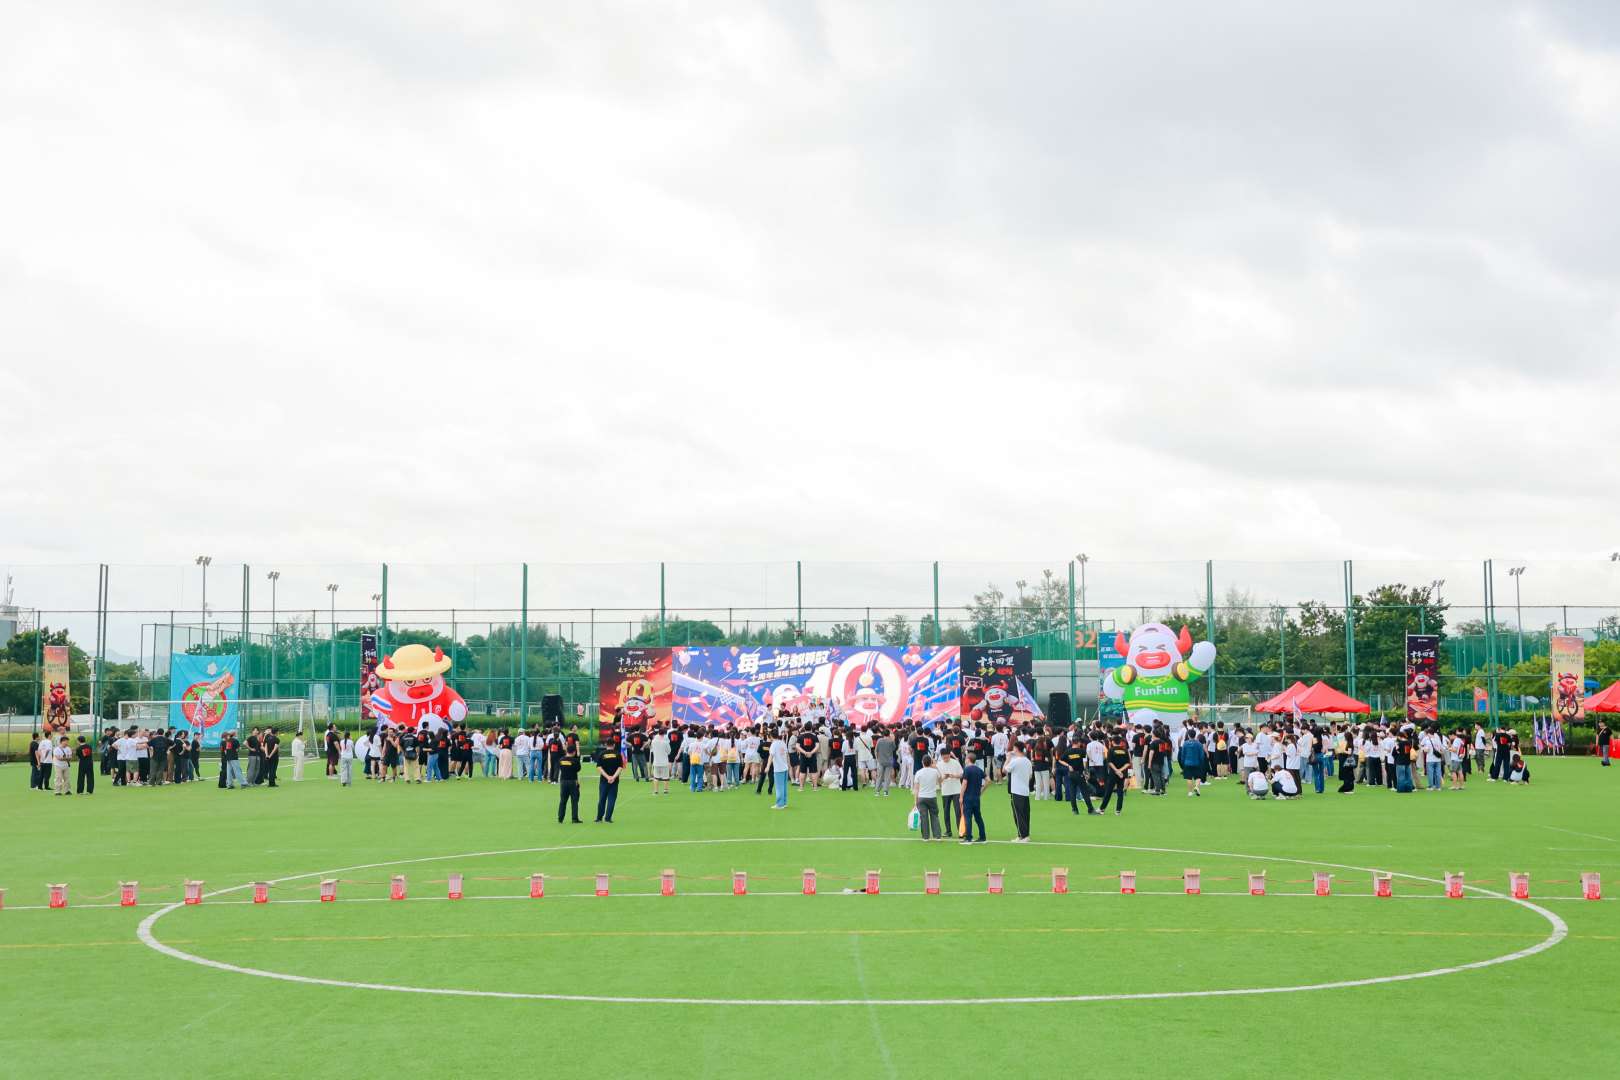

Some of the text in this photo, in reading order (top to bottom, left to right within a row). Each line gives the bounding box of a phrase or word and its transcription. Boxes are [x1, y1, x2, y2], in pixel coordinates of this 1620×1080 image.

[1075, 630, 1096, 648] 32
[737, 650, 830, 674] 每一步都算数
[750, 667, 812, 681] 十周年趣味运动会
[1134, 685, 1178, 696] FunFun
